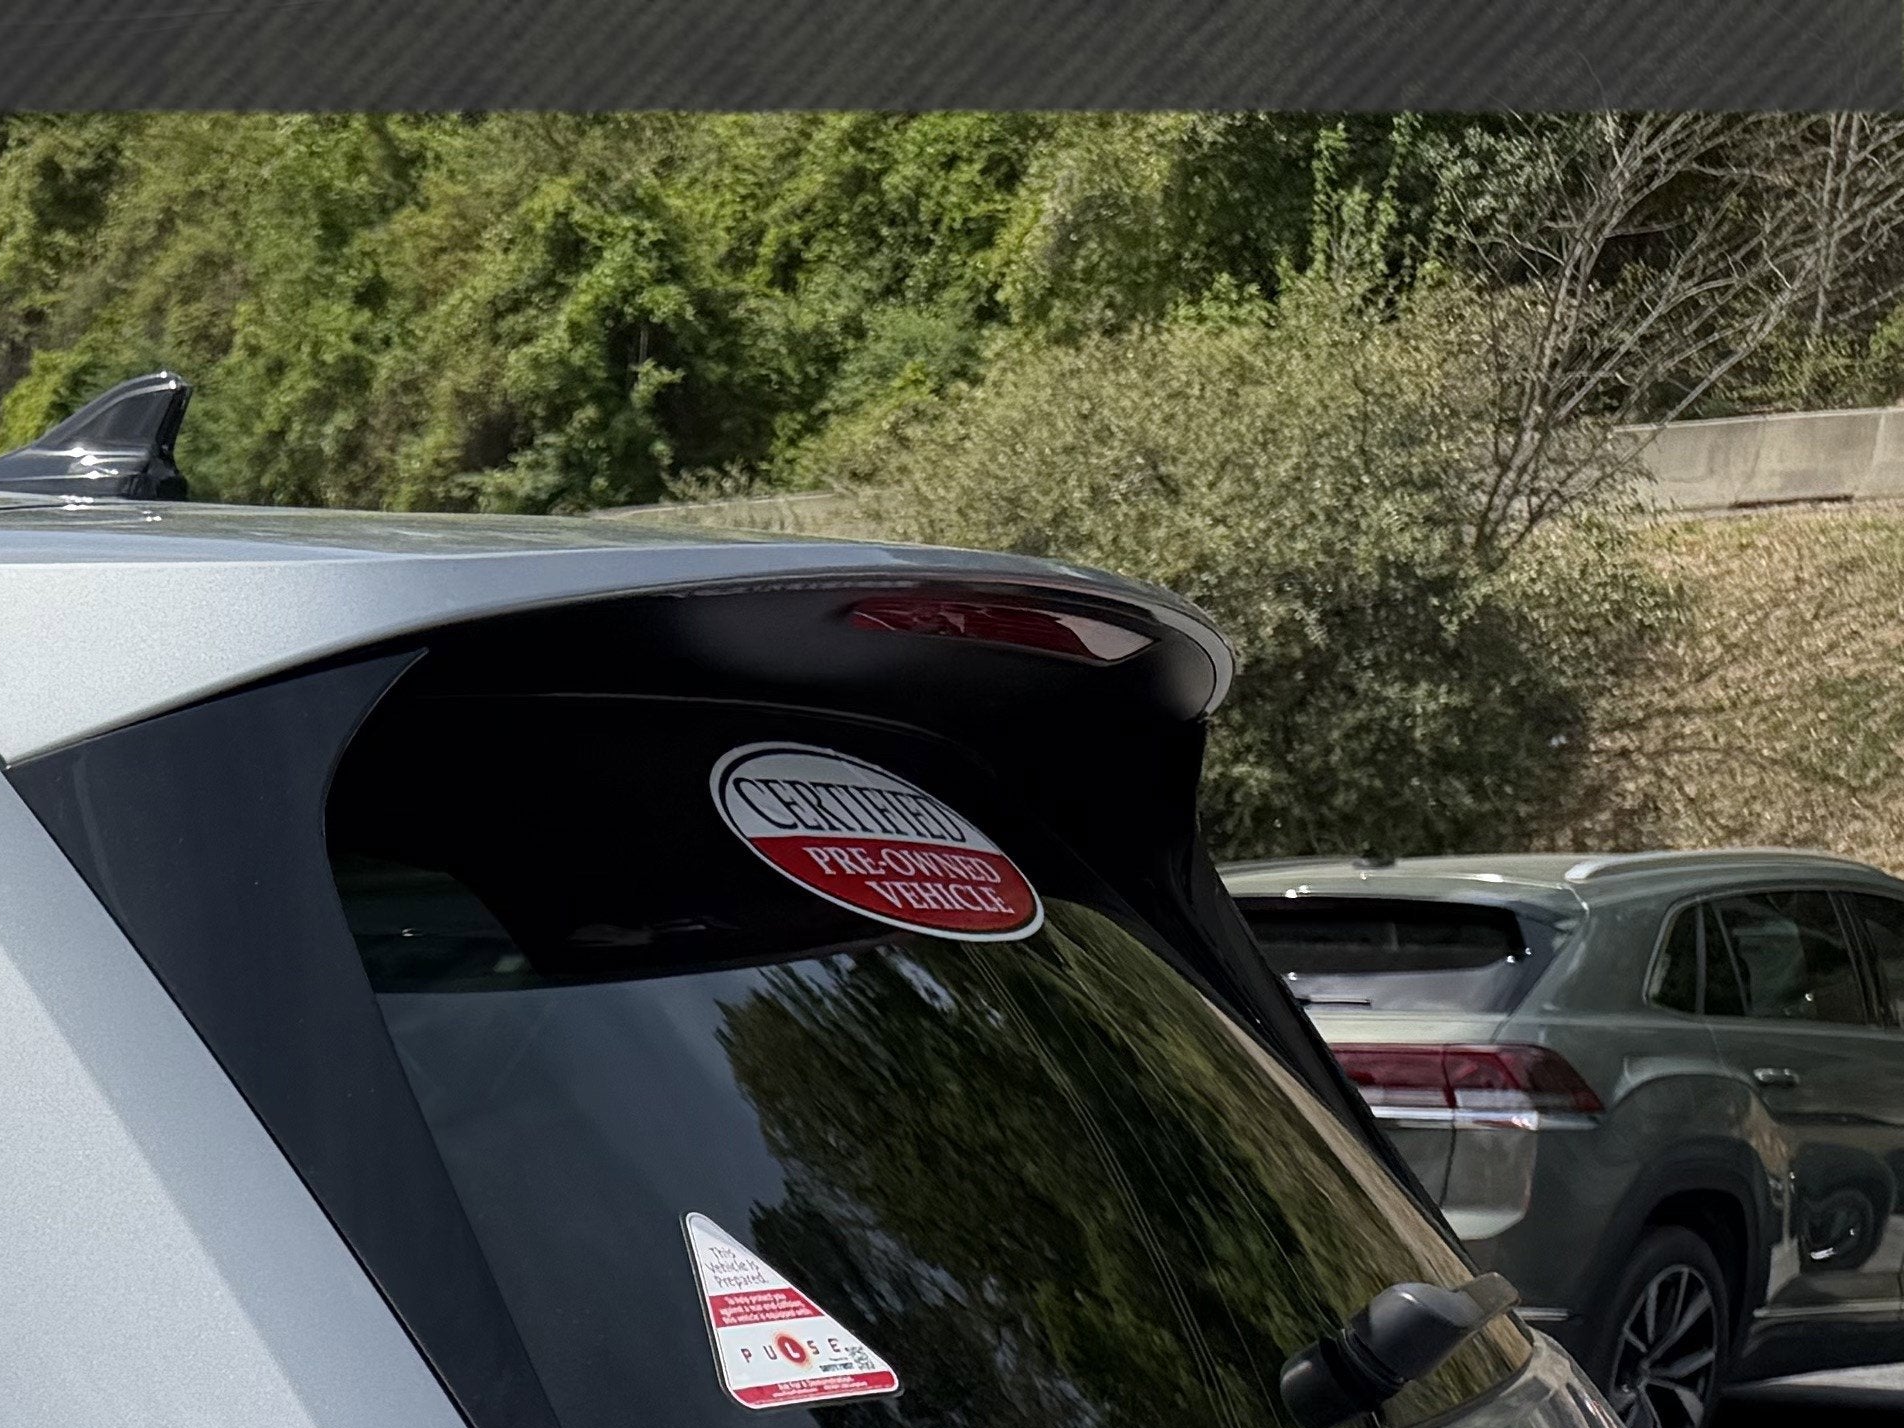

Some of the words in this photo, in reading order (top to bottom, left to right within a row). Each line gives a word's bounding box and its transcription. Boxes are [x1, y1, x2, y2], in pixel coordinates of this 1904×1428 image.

[733, 777, 966, 843] CERTIFIED
[802, 846, 1002, 884] PRE-OWNED
[865, 880, 1016, 914] VEHICLE
[741, 1337, 841, 1363] PULSE
